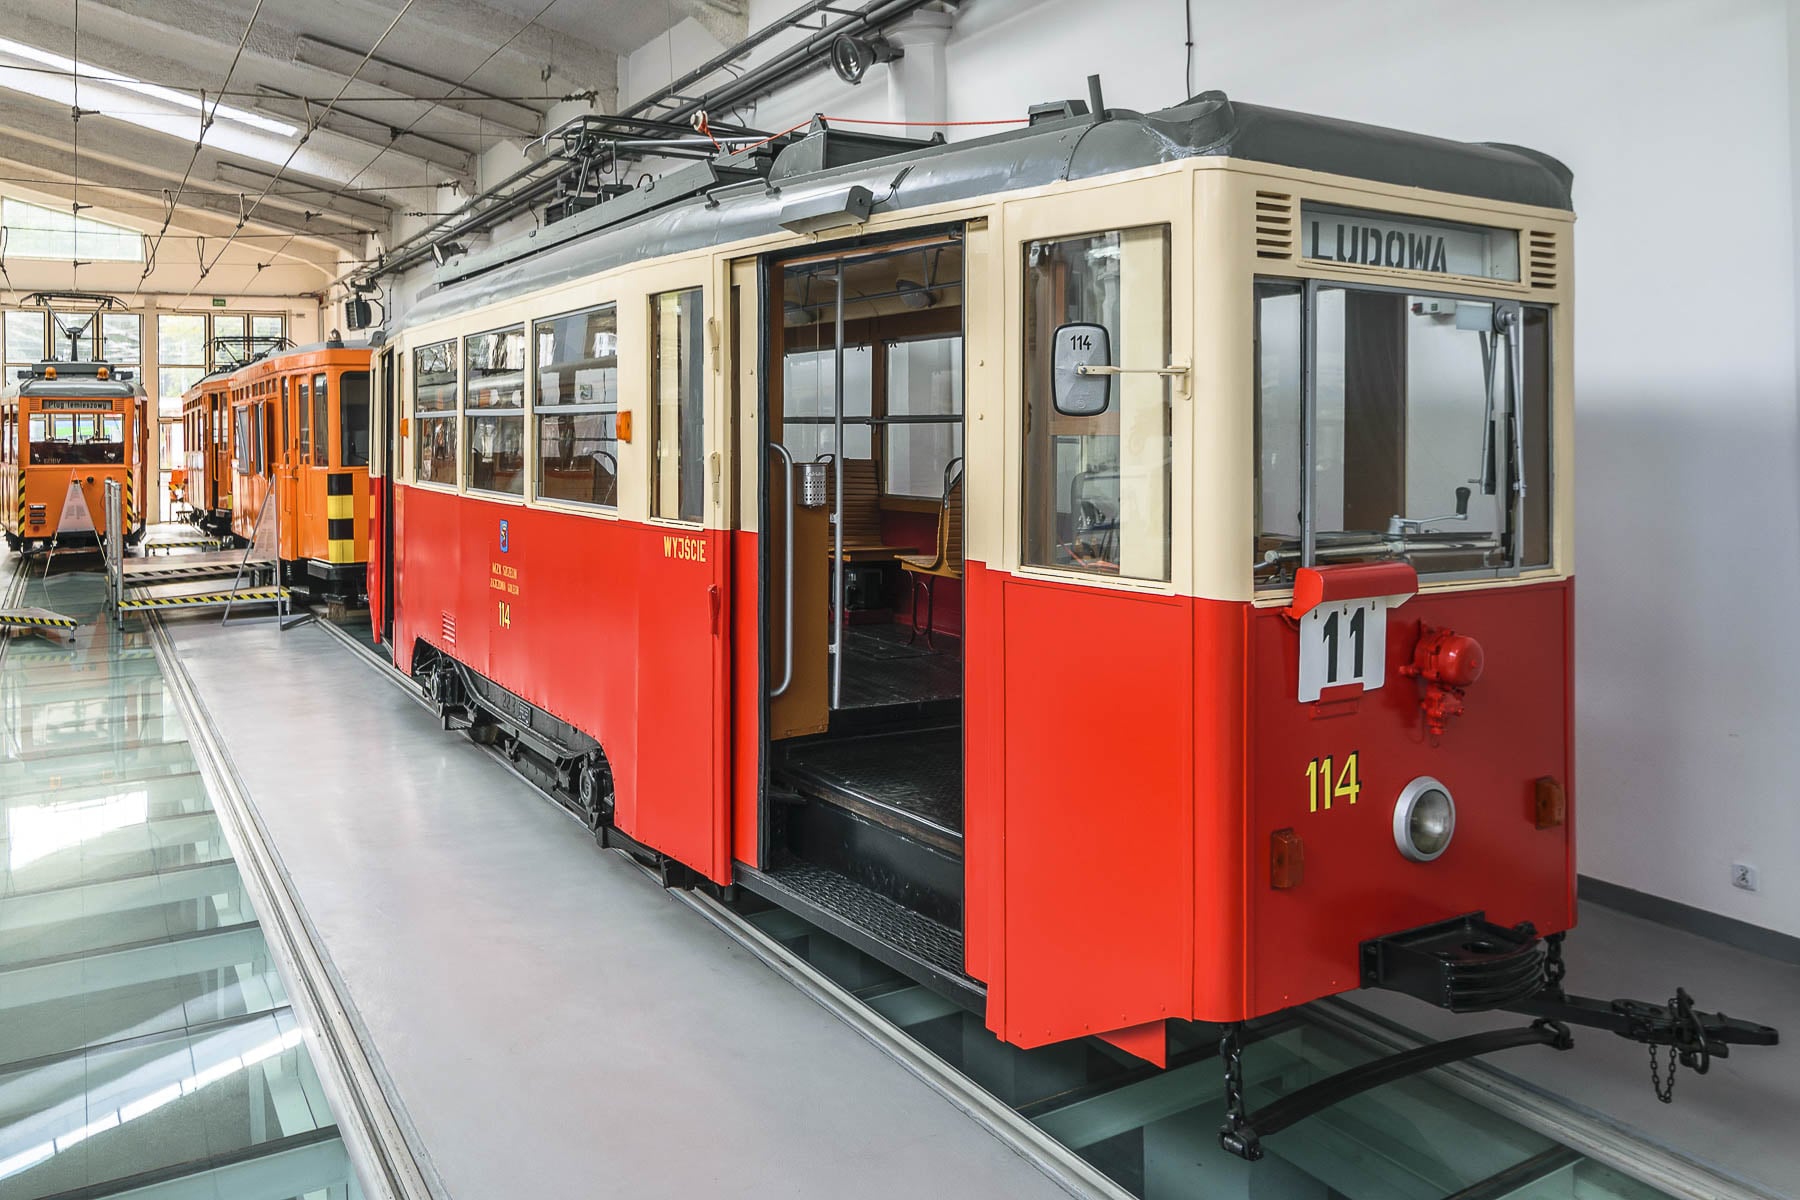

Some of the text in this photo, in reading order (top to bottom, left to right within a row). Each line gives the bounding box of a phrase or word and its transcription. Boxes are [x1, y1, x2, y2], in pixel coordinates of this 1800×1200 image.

[1311, 221, 1447, 273] LUDOWA
[1070, 335, 1092, 350] 114
[663, 535, 707, 562] WYJŚCIE
[498, 600, 511, 630] 114
[1323, 606, 1365, 684] 11
[1305, 750, 1362, 813] 114
